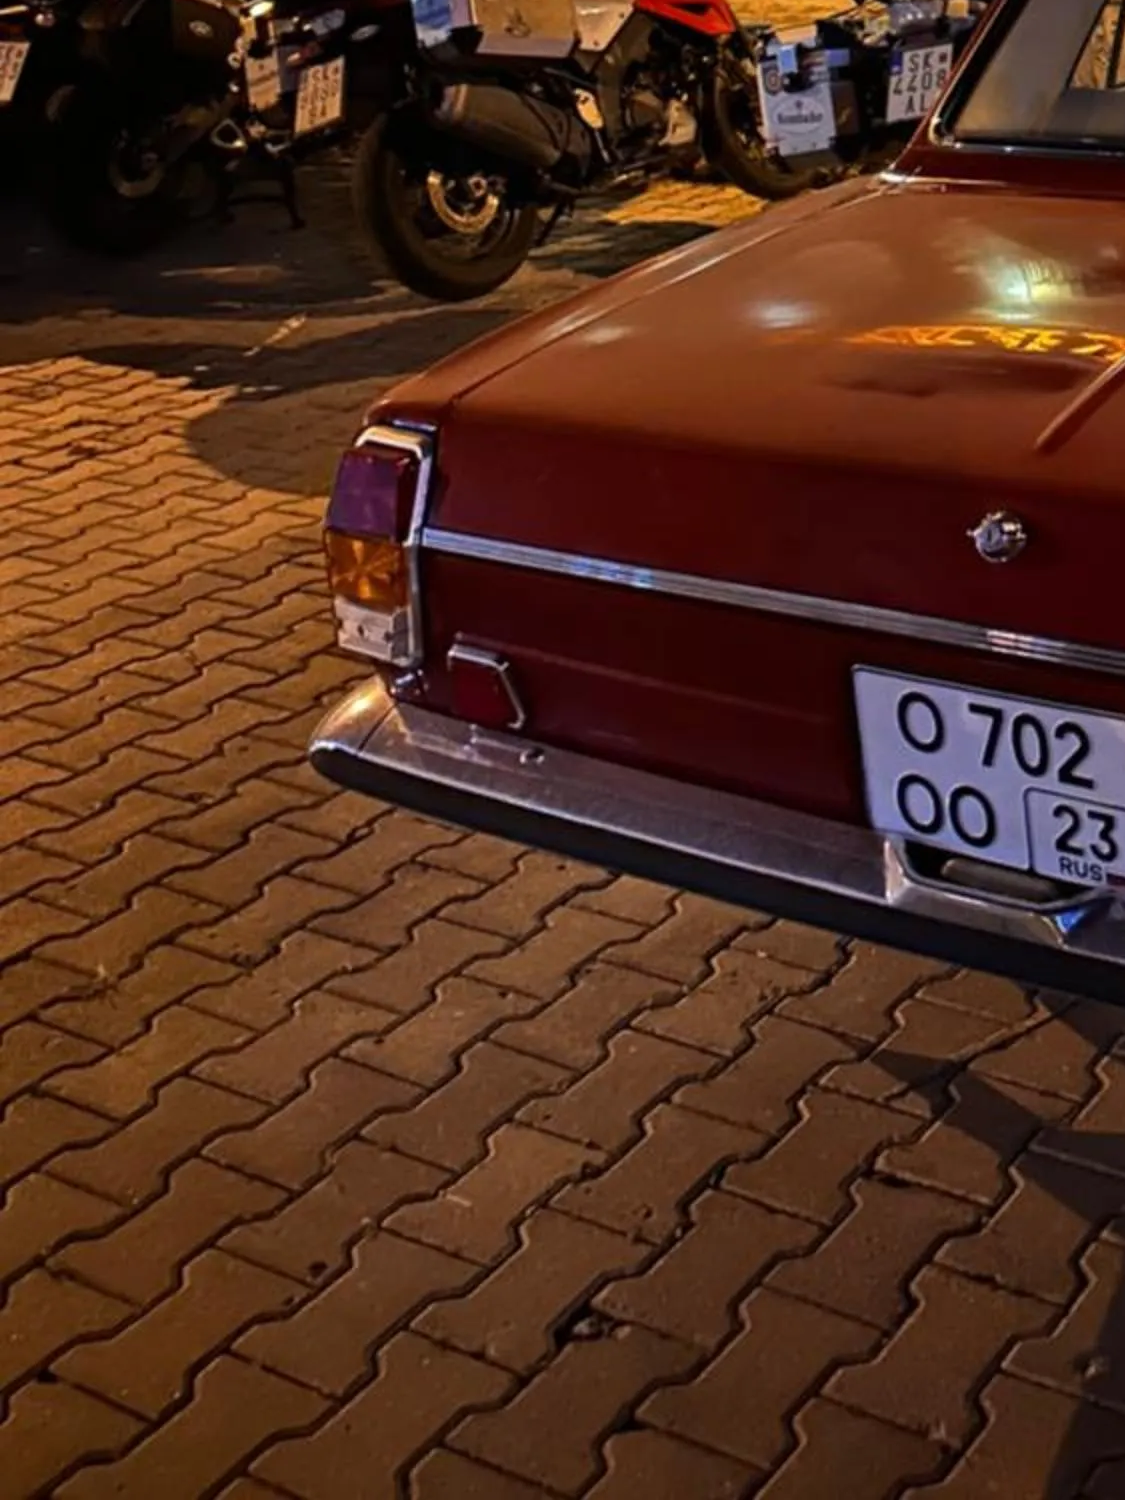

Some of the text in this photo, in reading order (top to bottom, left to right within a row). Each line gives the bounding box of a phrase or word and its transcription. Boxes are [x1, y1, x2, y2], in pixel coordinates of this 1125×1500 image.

[908, 50, 934, 73] SK
[896, 690, 1096, 790] O 702
[1052, 804, 1119, 863] 23
[1059, 856, 1104, 882] RUS
